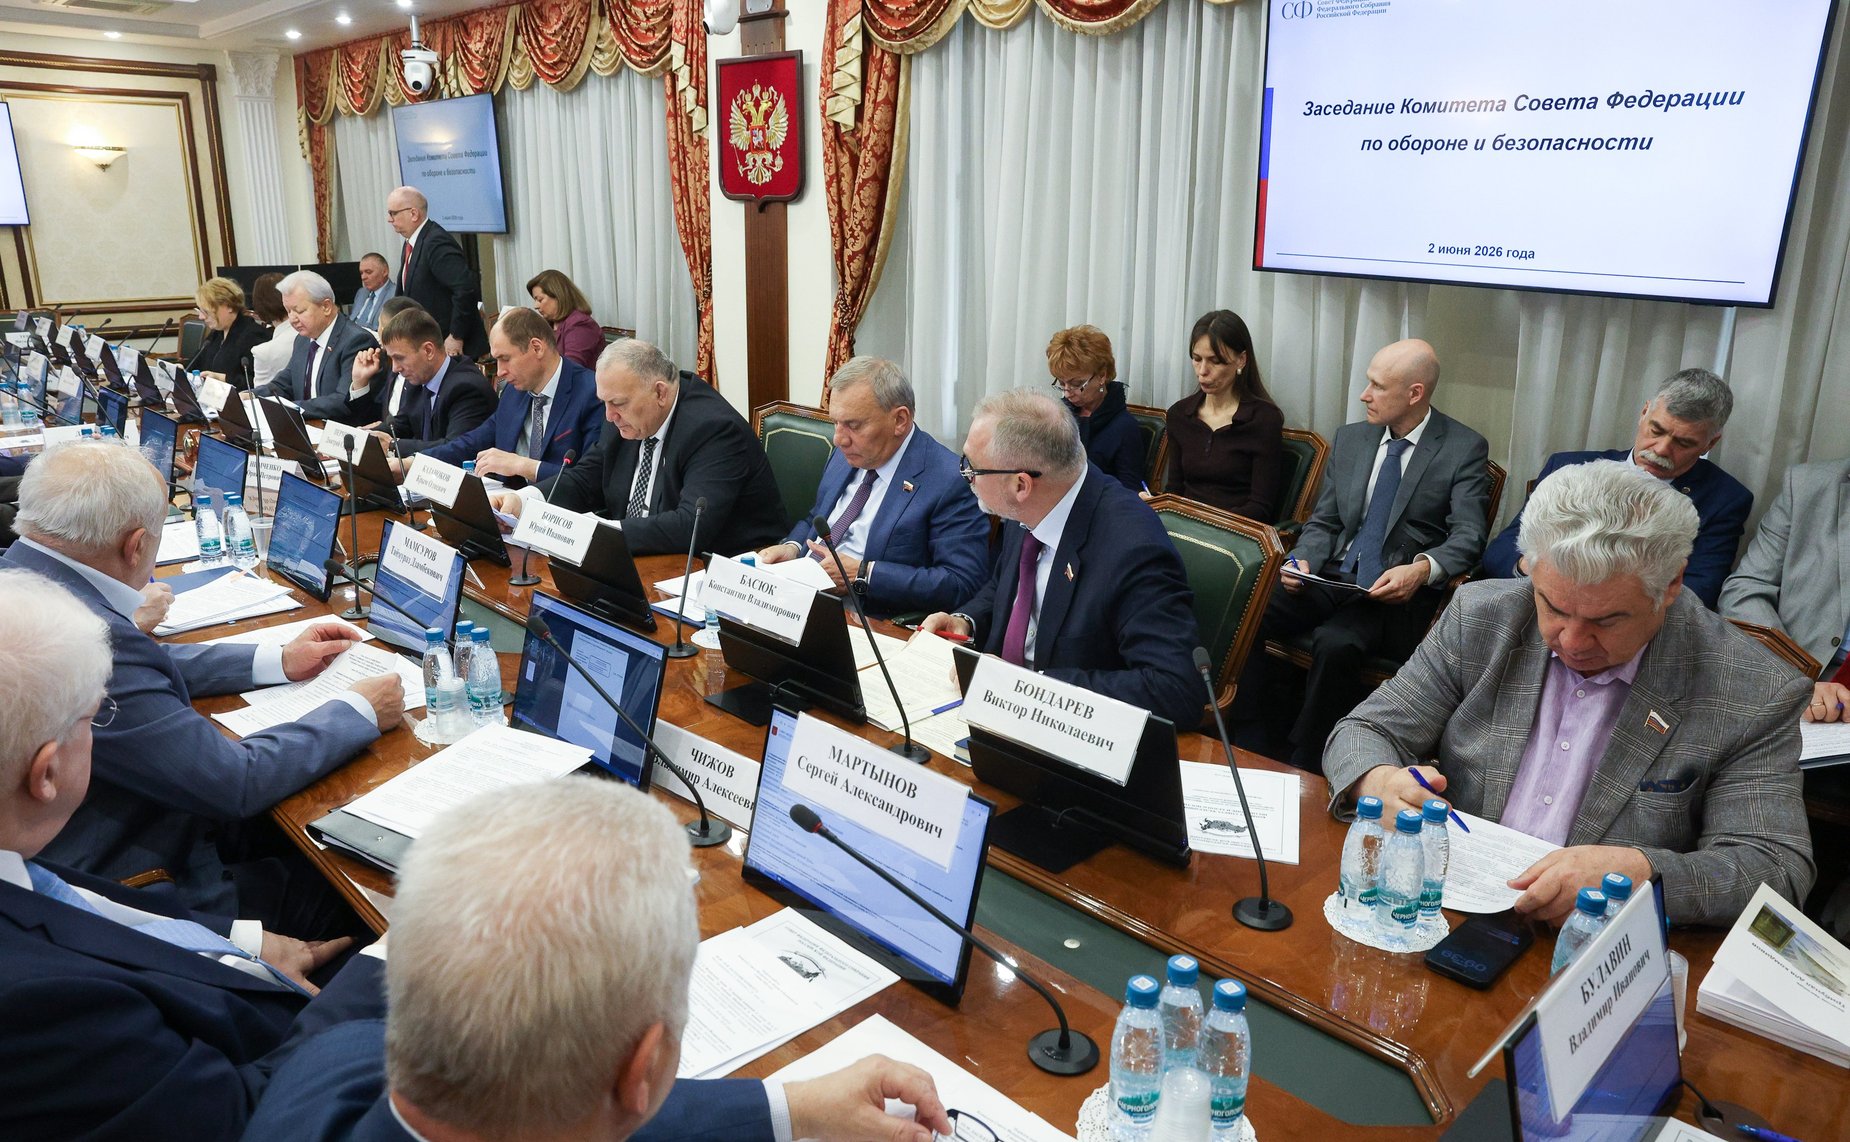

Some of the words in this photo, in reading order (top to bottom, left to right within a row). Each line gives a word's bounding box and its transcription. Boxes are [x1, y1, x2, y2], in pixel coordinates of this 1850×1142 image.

[1281, 1, 1313, 20] СФ
[1303, 98, 1395, 117] Заседание
[1400, 96, 1507, 114] Комитета
[1513, 93, 1598, 113] Совета
[1606, 87, 1745, 113] Федерации
[1360, 137, 1383, 152] по
[1388, 134, 1469, 155] обороне
[1474, 137, 1486, 152] и
[1491, 133, 1654, 152] безопасности
[1427, 243, 1436, 254] 2
[1438, 245, 1471, 257] июня
[1474, 245, 1503, 258] 2026
[1506, 248, 1536, 261] года
[528, 520, 546, 534] Юрий
[545, 527, 576, 547] Иванович
[541, 511, 574, 530] БОРИСОВ
[404, 536, 438, 562] МАМСУРОВ
[707, 579, 748, 601] Константин
[747, 593, 802, 622] Владимирович
[739, 574, 778, 596] БАСЮК
[1013, 678, 1095, 720] БОНДАРЕВ
[983, 688, 1028, 720] Виктор
[1029, 706, 1115, 752] Николаевич
[690, 747, 735, 779] ЧИЖОВ
[827, 744, 919, 799] МАРТЫНОВ
[797, 754, 839, 787] Сергей
[839, 776, 944, 839] Александрович
[1579, 932, 1632, 1006] БУЛАВИН
[1567, 994, 1614, 1056] Владимир
[1612, 948, 1651, 1002] Иванович
